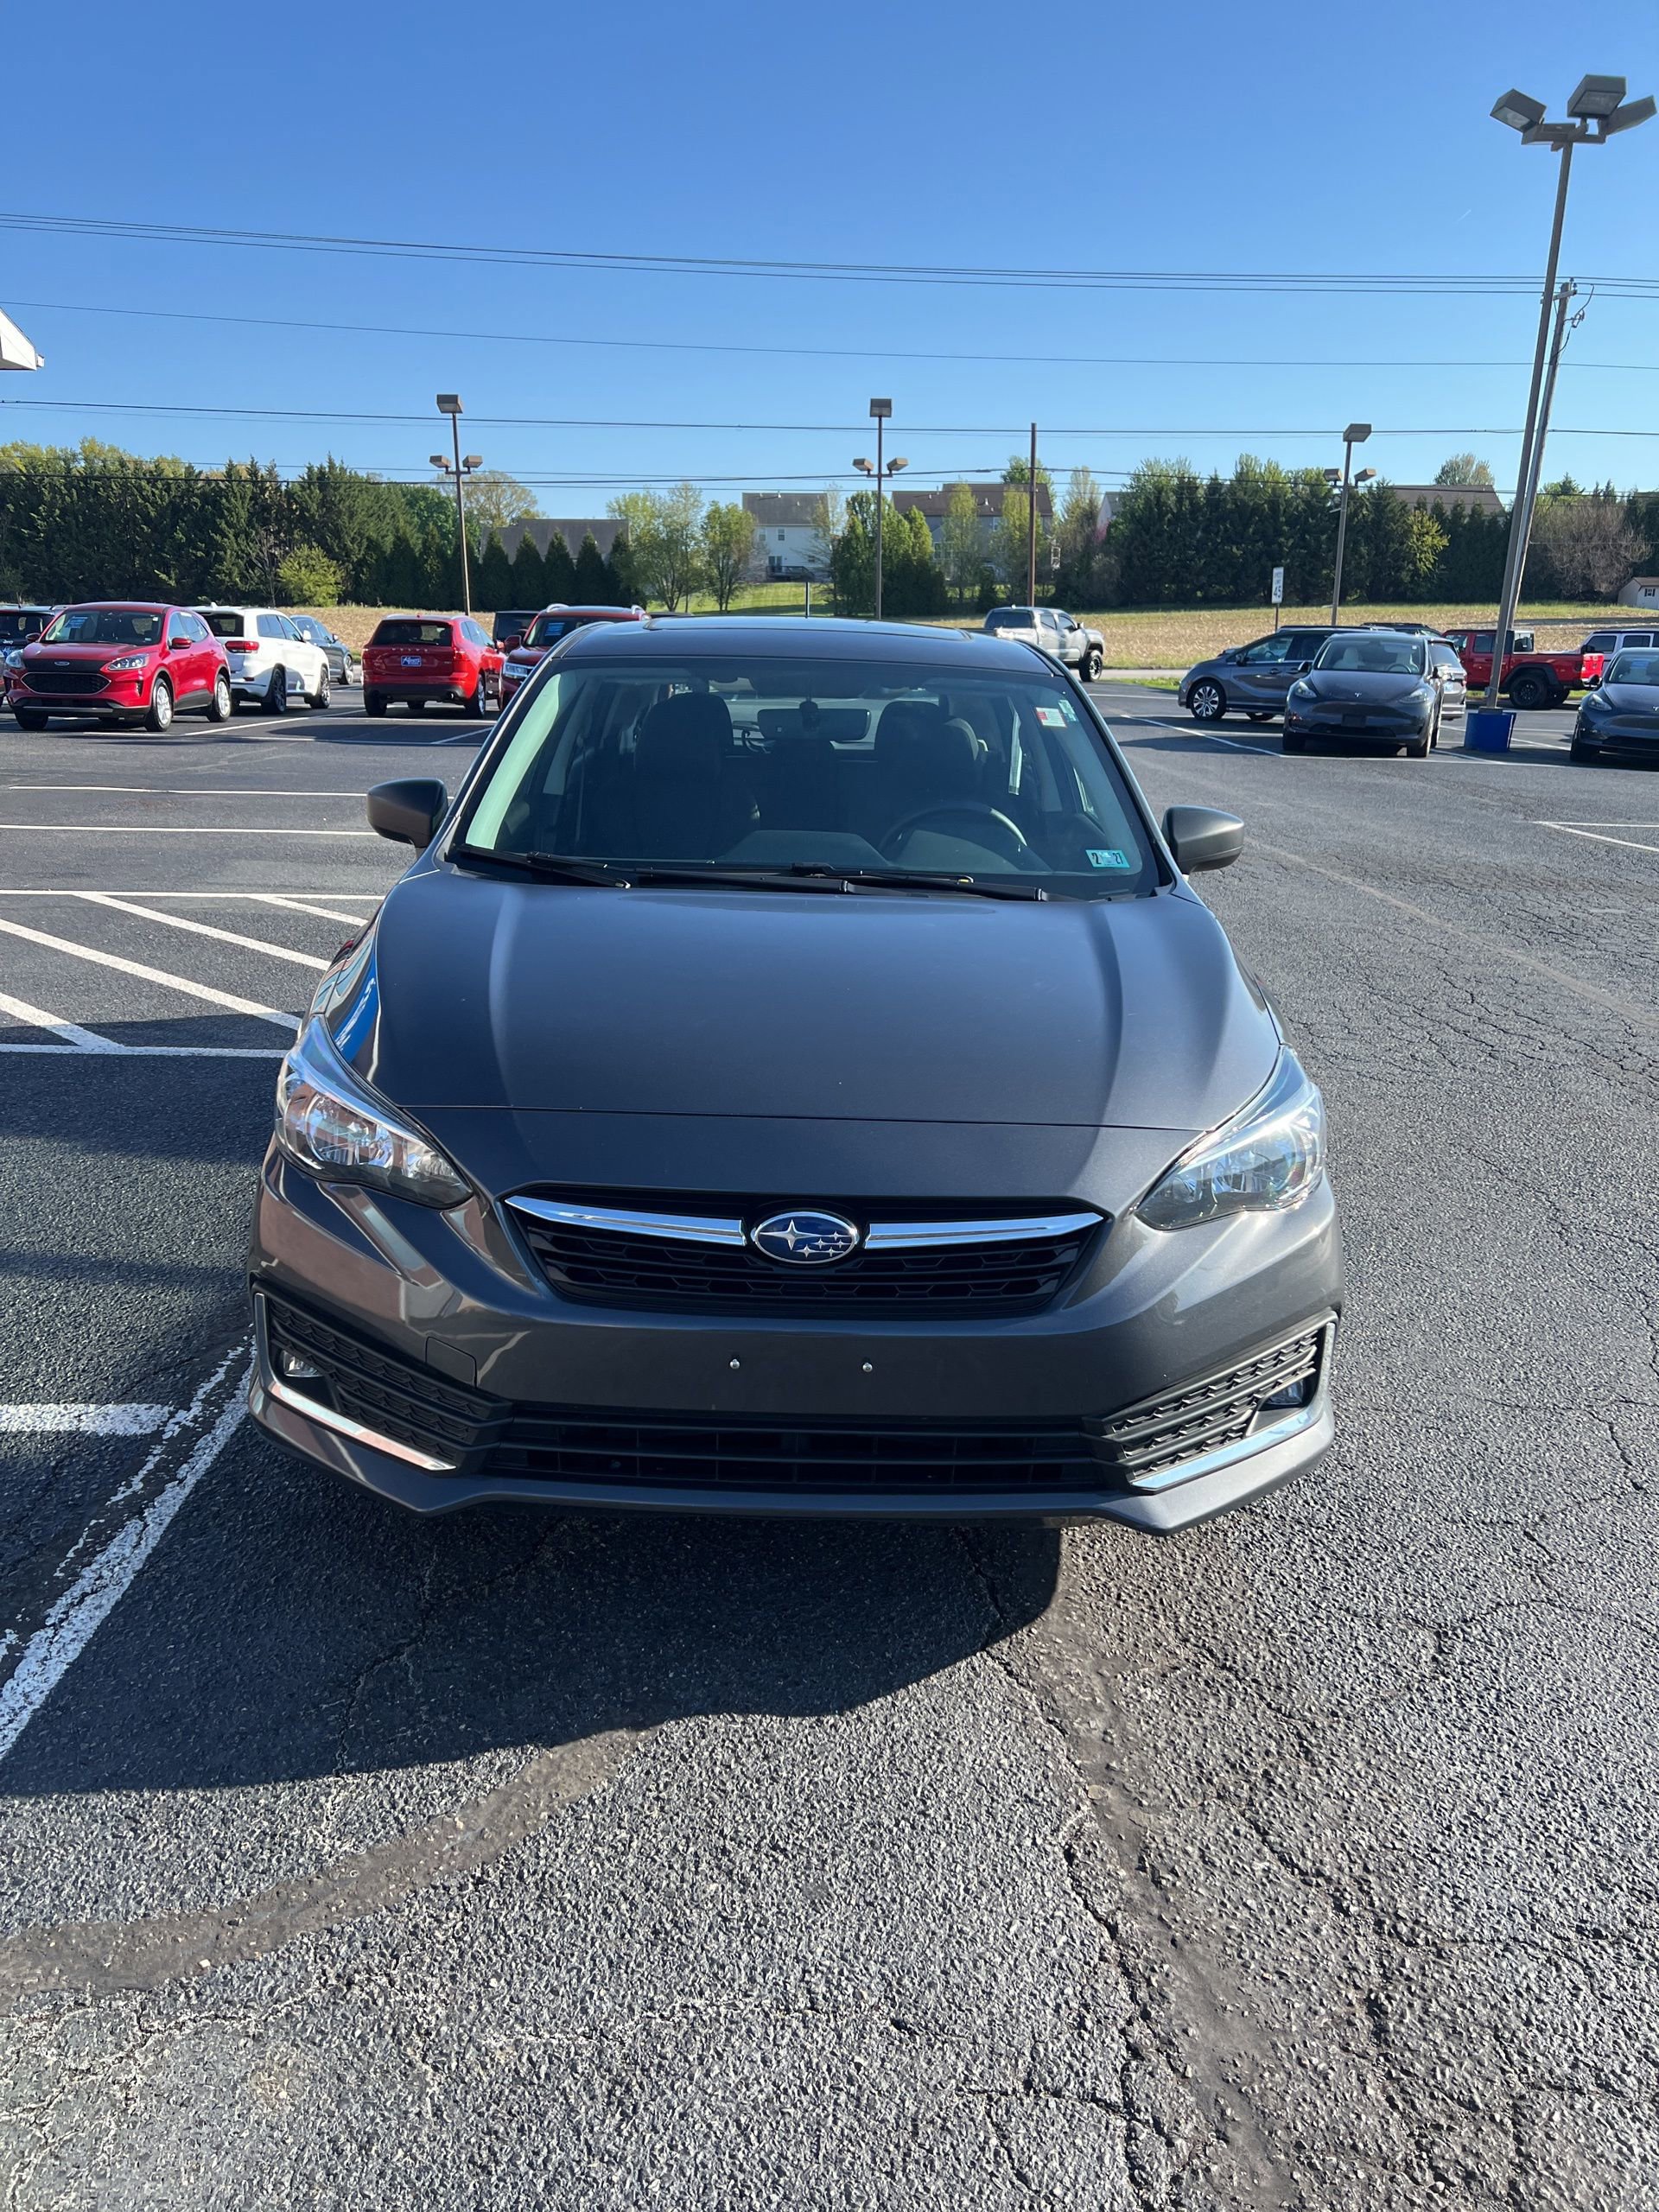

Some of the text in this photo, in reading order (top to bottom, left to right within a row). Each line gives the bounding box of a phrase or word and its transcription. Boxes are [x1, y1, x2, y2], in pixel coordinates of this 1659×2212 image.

[1273, 585, 1282, 598] 45
[1091, 852, 1124, 865] 2 27
